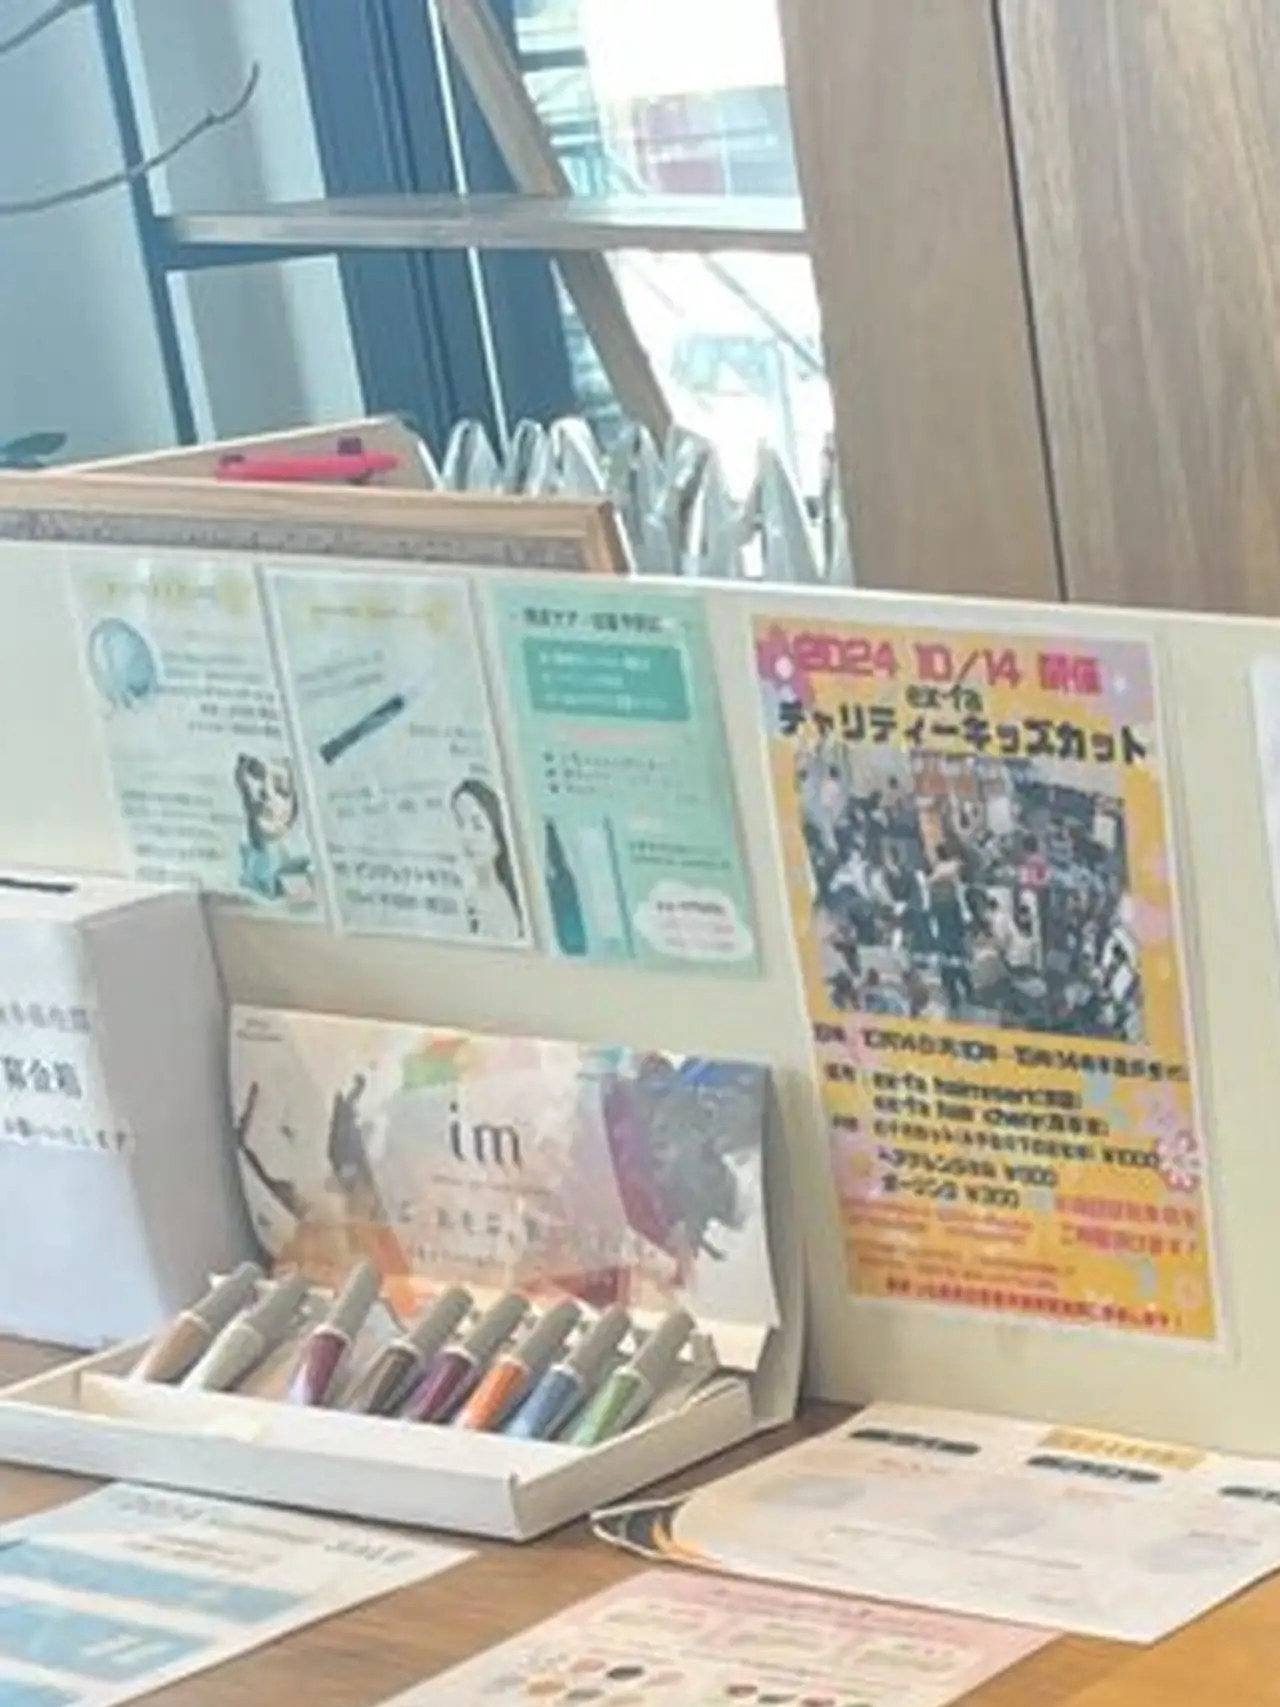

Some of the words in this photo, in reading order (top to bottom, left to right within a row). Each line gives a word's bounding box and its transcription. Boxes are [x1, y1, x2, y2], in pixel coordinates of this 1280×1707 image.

[797, 633, 898, 678] 2024
[914, 641, 1022, 688] 10/14
[779, 700, 1149, 767] チャリティーキッズカット
[448, 1101, 523, 1168] im
